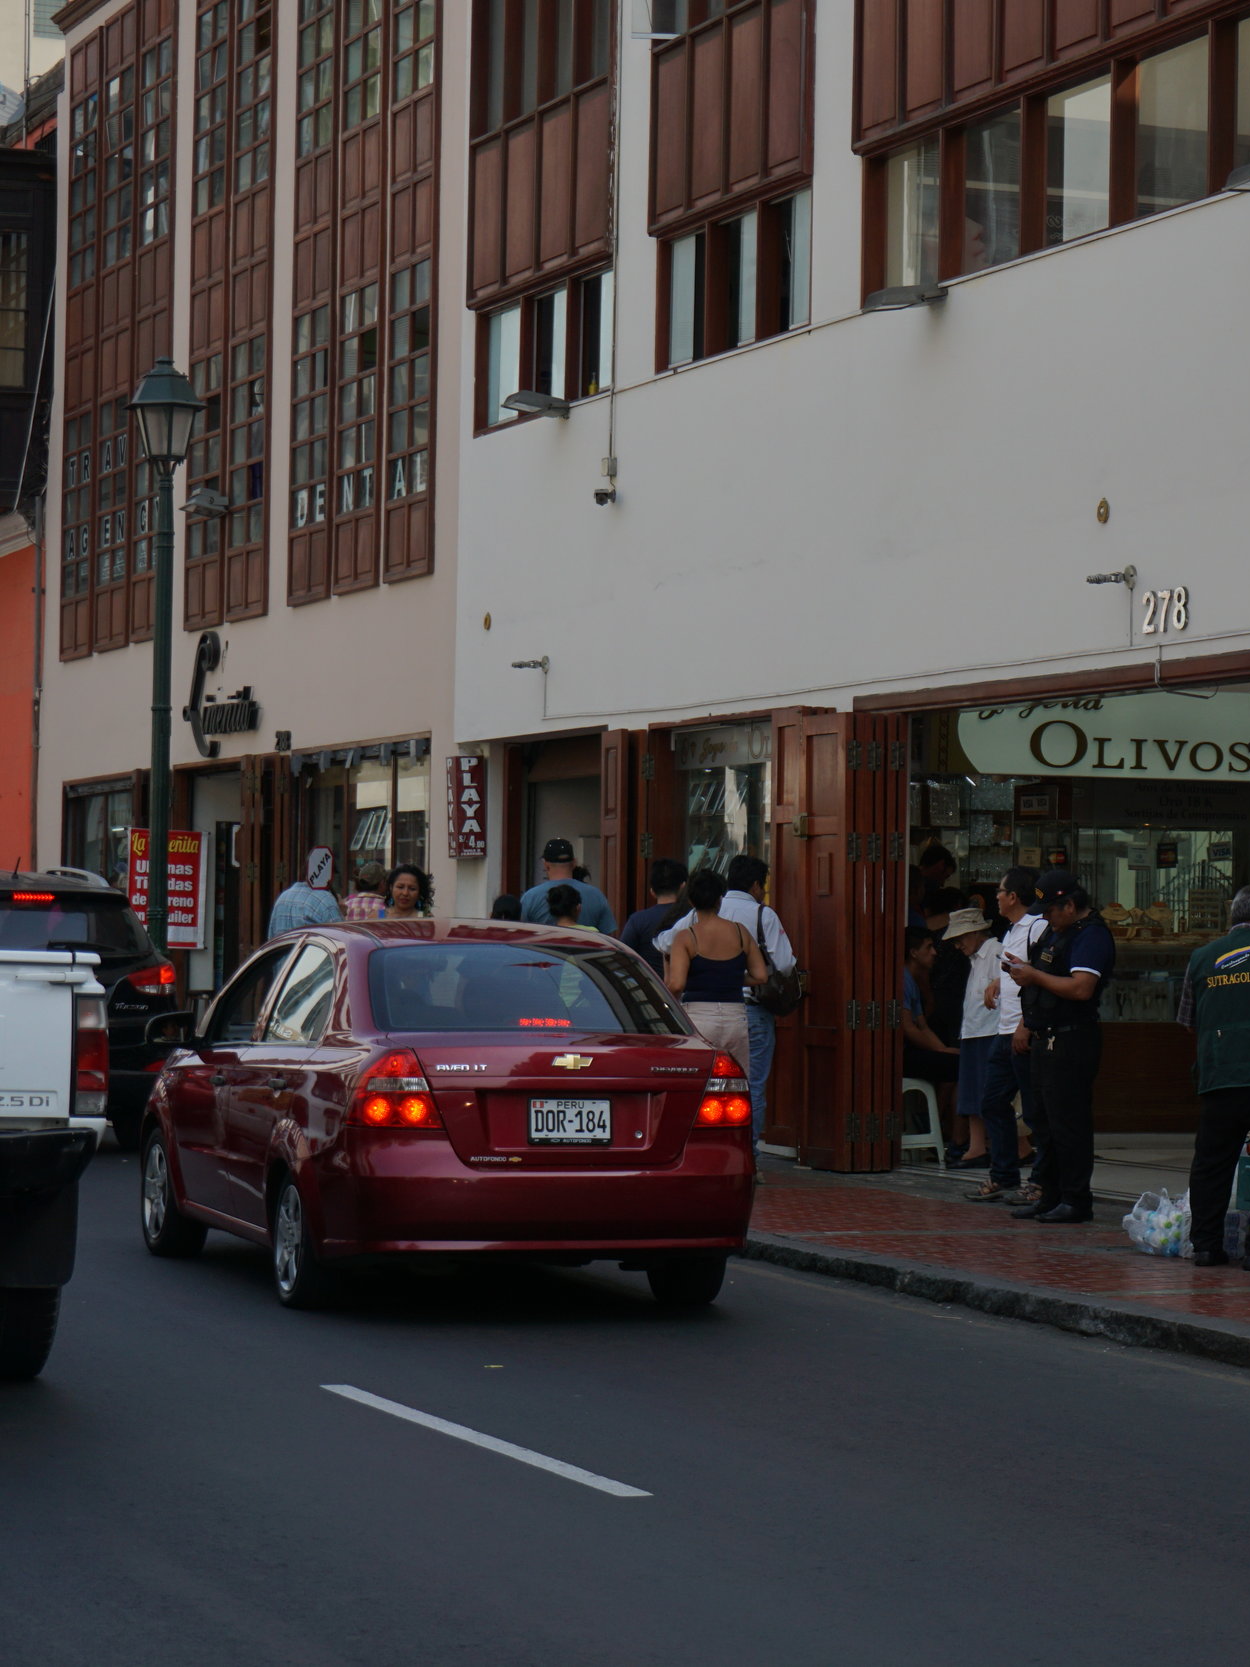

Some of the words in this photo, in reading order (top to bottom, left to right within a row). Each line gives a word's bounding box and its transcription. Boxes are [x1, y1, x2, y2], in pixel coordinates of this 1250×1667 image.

[297, 450, 427, 528] DENTAL
[1142, 586, 1189, 634] 278
[1159, 782, 1171, 793] de
[446, 759, 456, 833] PLAYA
[460, 758, 482, 833] PLAYA
[1159, 796, 1183, 807] Oro
[1167, 808, 1178, 819] de
[132, 832, 146, 856] La
[1212, 847, 1231, 857] VISA
[309, 852, 332, 885] PLAYA
[134, 875, 194, 892] Tidas
[131, 892, 147, 905] de
[29, 1096, 49, 1107] Di
[557, 1100, 585, 1109] PERU
